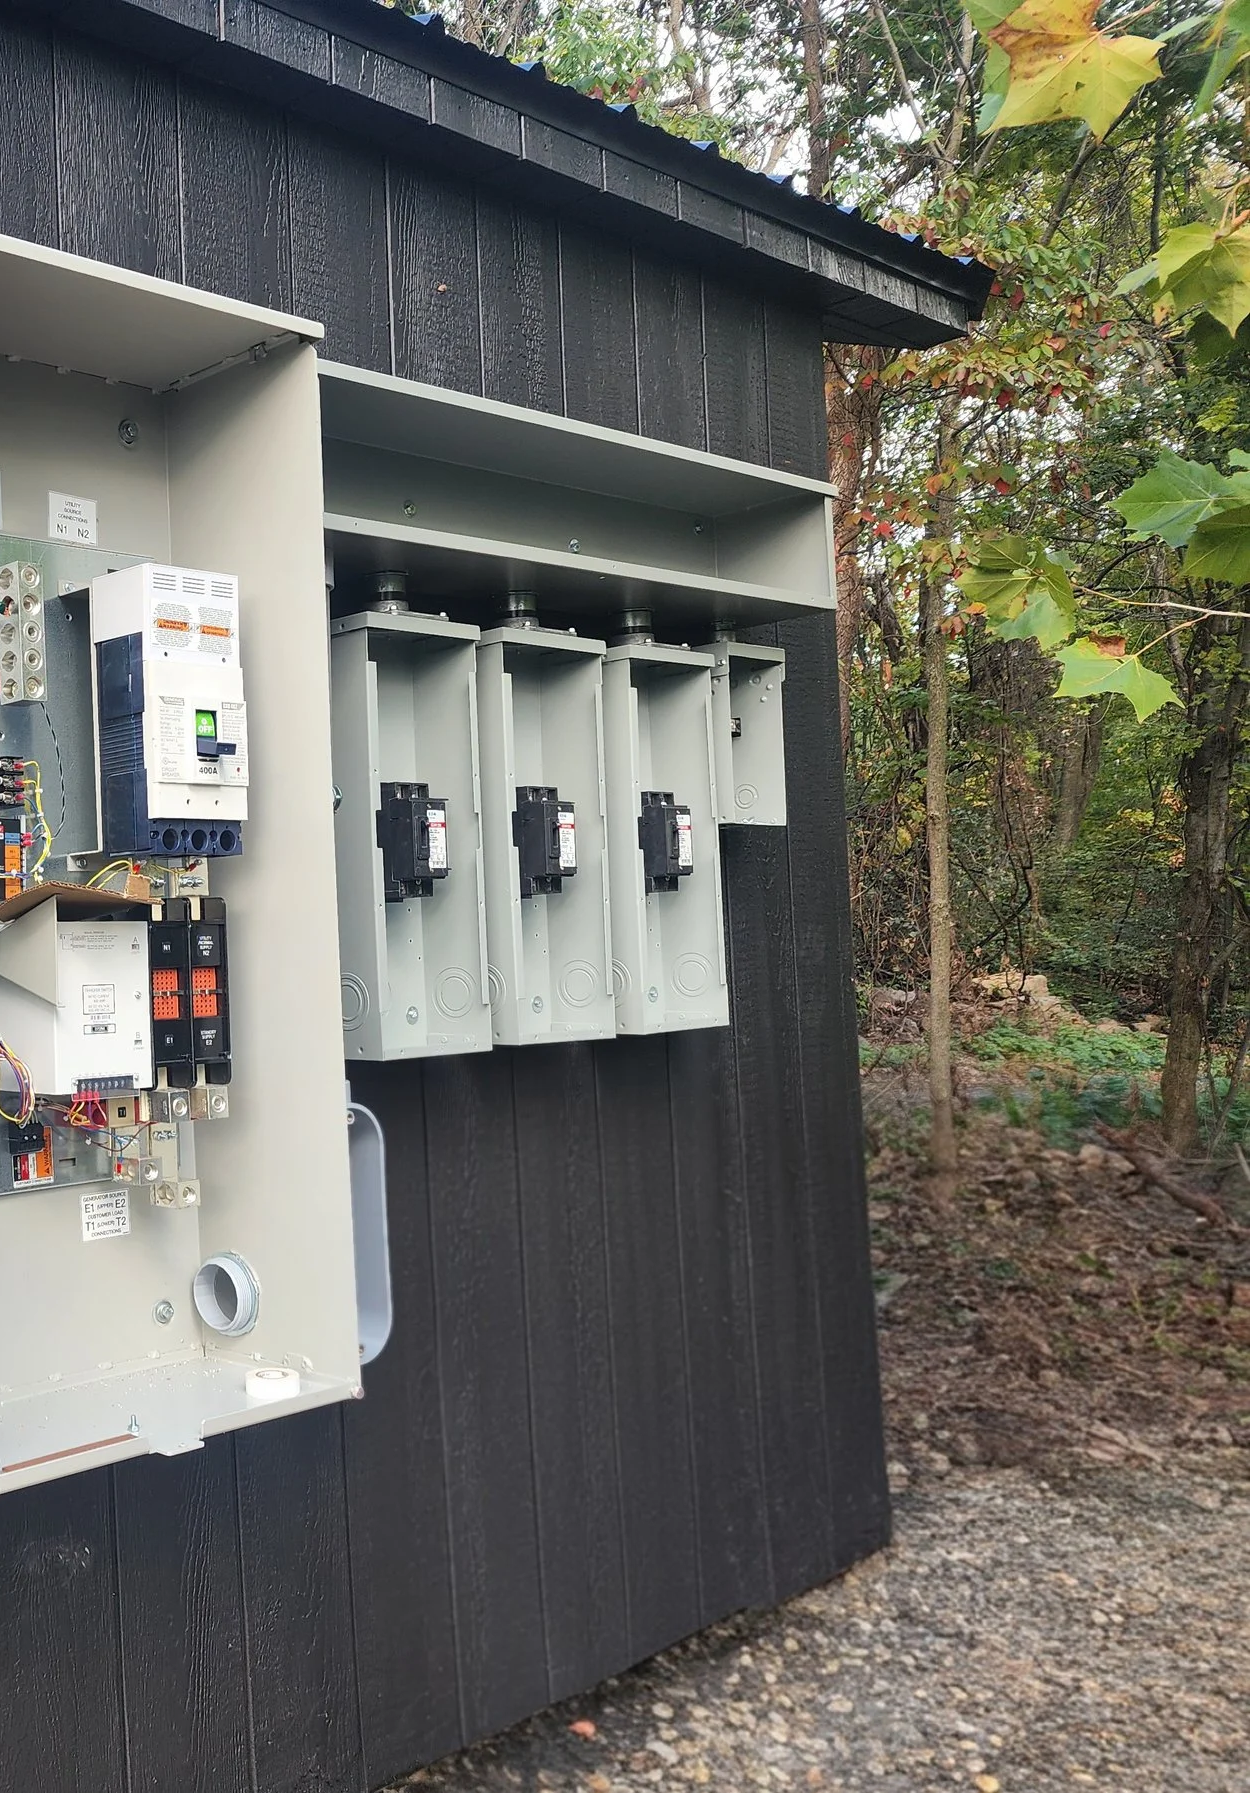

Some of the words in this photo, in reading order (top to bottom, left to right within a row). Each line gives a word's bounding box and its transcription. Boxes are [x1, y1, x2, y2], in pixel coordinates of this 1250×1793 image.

[57, 513, 88, 524] CONNECTIONS
[56, 523, 67, 534] N1
[77, 528, 89, 539] N2
[197, 725, 214, 734] OFF
[198, 766, 219, 775] 400A
[163, 944, 171, 952] N1
[166, 1036, 174, 1044] E1
[82, 1194, 108, 1202] GENERATOR
[108, 1191, 127, 1199] SOURCE
[84, 1203, 95, 1213] E1
[115, 1198, 127, 1208] E2
[87, 1211, 112, 1220] CUSTOMER
[85, 1221, 95, 1231] T1
[115, 1216, 127, 1226] T2
[91, 1227, 123, 1237] CONNECTIONS
